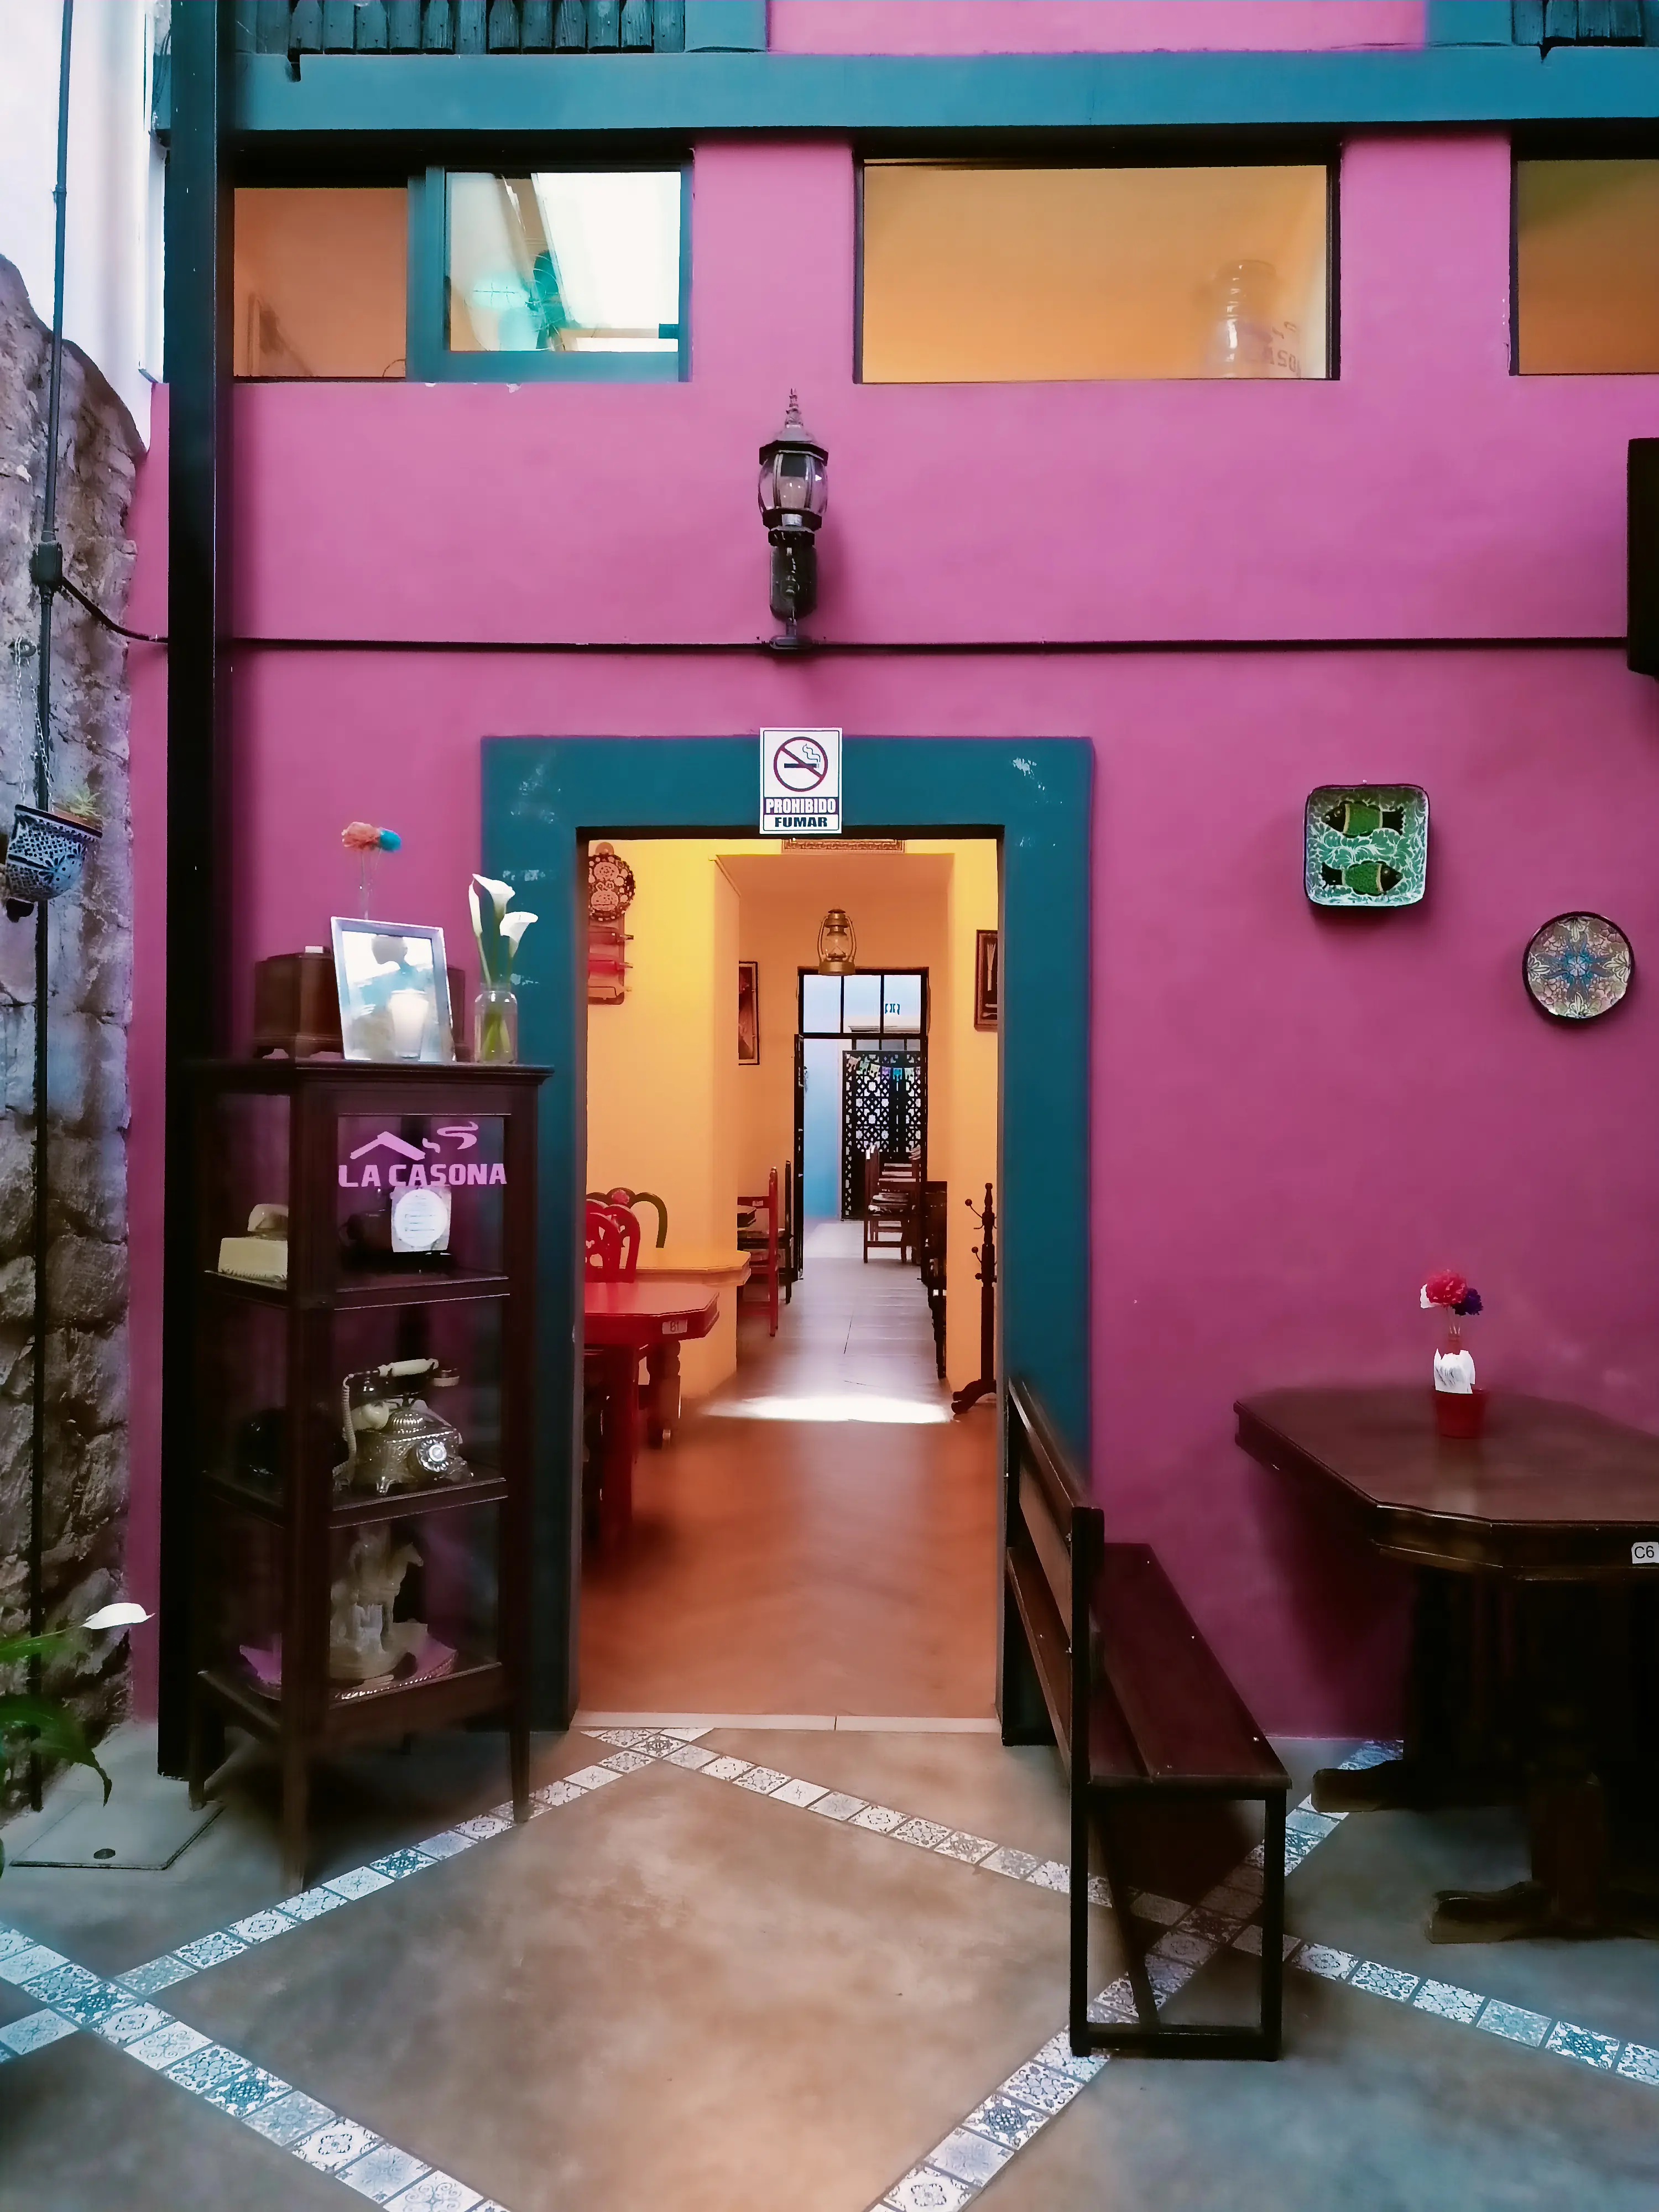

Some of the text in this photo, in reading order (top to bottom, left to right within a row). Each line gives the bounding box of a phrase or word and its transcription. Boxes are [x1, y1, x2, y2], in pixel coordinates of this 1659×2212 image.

[765, 798, 836, 813] PROHIBIDO
[775, 817, 827, 827] FUMAR
[338, 1163, 507, 1187] LA CASONA
[1634, 1545, 1655, 1559] C6
